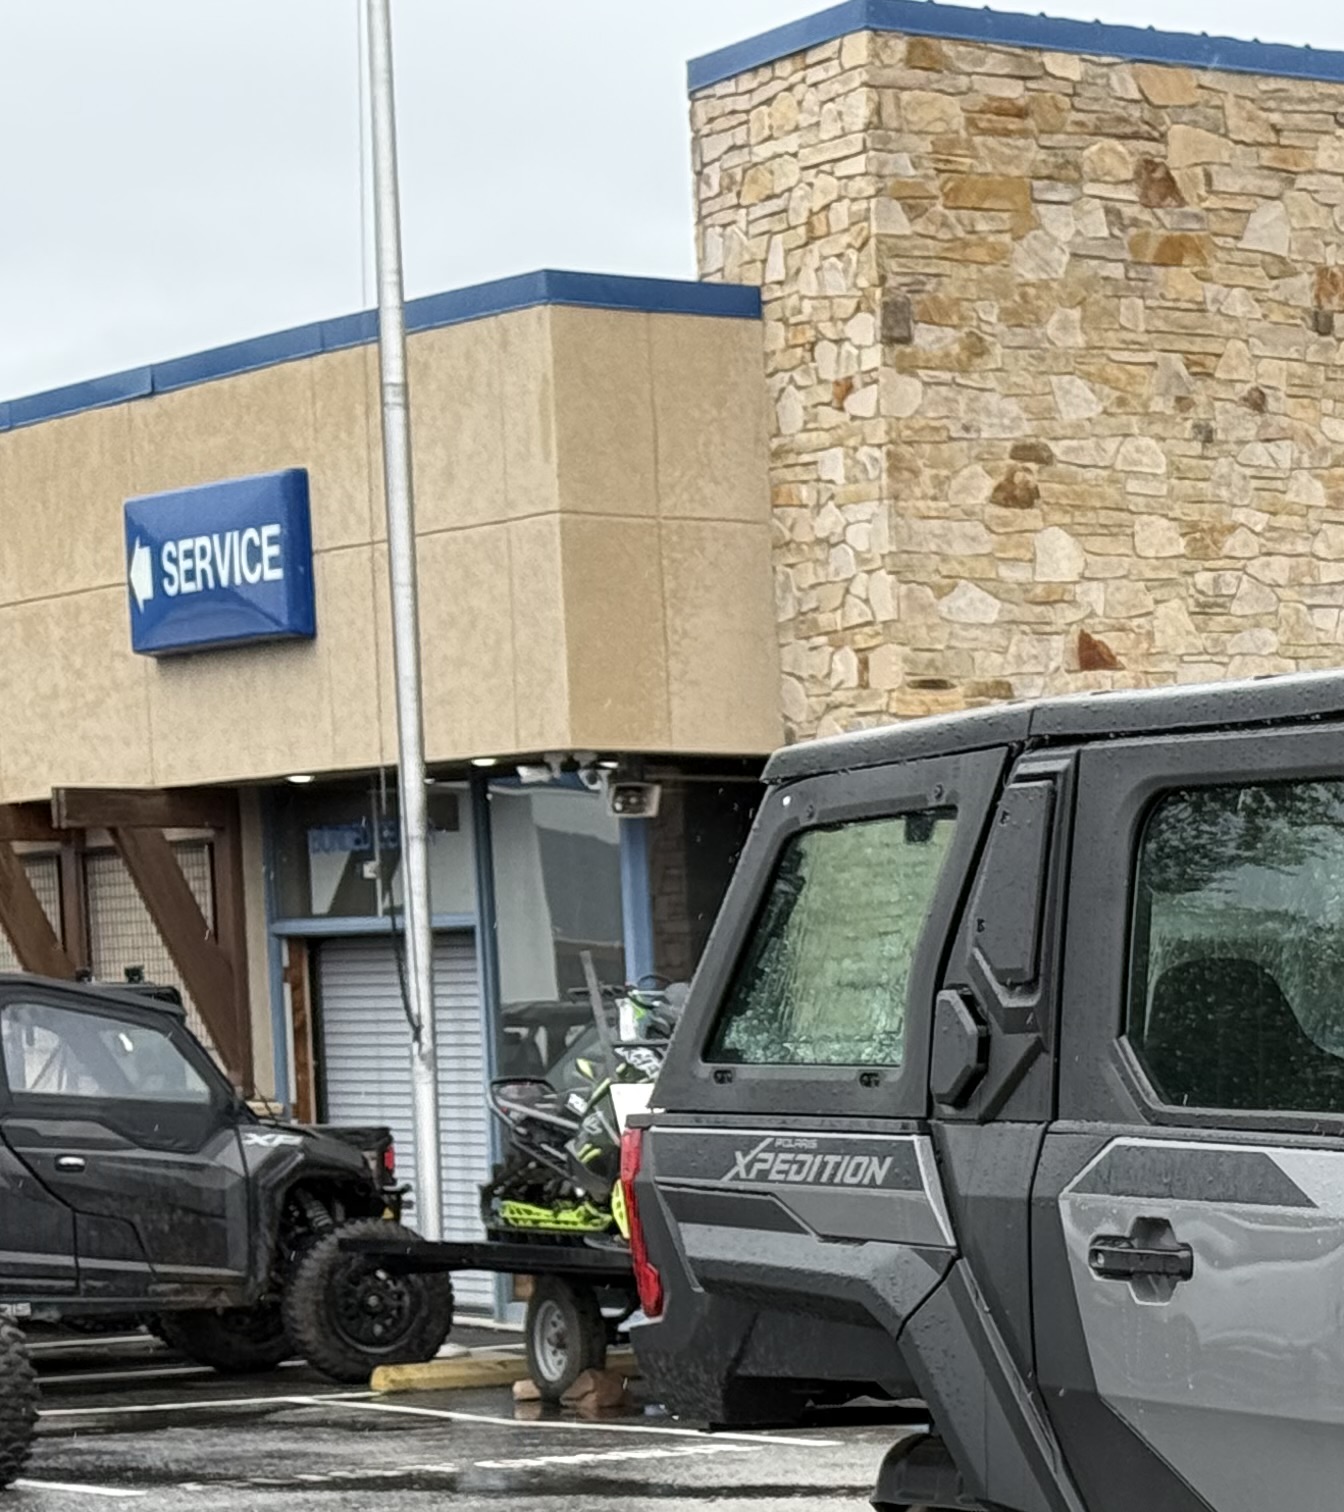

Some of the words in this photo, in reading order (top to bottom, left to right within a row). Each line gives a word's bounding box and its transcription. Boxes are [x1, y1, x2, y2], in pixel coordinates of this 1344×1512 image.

[162, 524, 284, 597] SERVICE
[720, 1137, 895, 1186] XPEDITION
[774, 1138, 818, 1149] POLARIS
